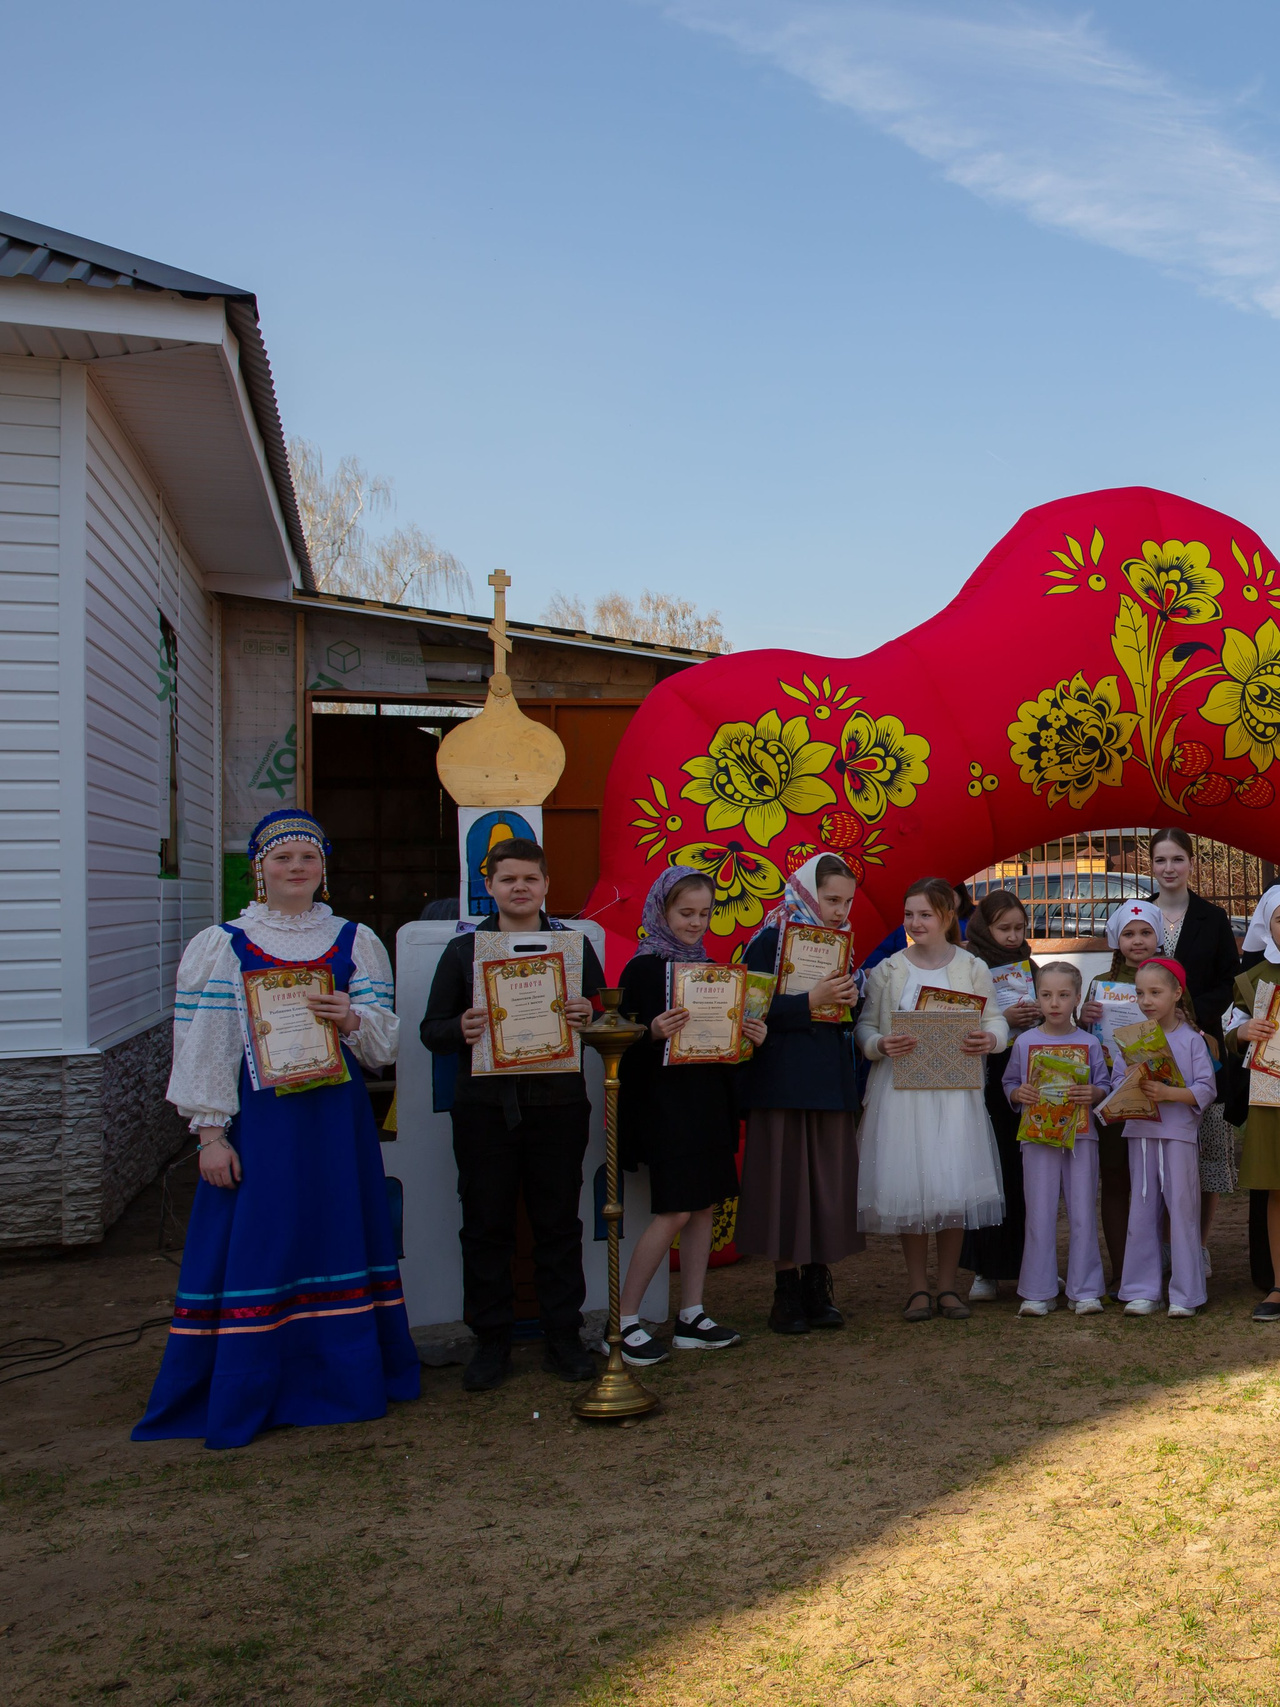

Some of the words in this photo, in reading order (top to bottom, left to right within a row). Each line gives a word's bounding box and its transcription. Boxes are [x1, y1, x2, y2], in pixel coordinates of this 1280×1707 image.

[248, 739, 279, 788] ТЕХНОНИКОЛЬ
[802, 945, 830, 955] ГРАМОТА
[510, 979, 542, 990] ГРАМОТА
[695, 986, 725, 994] ГРАМОТА
[272, 990, 307, 1002] ГРАМОТА
[1103, 990, 1138, 1003] ГРАМО
